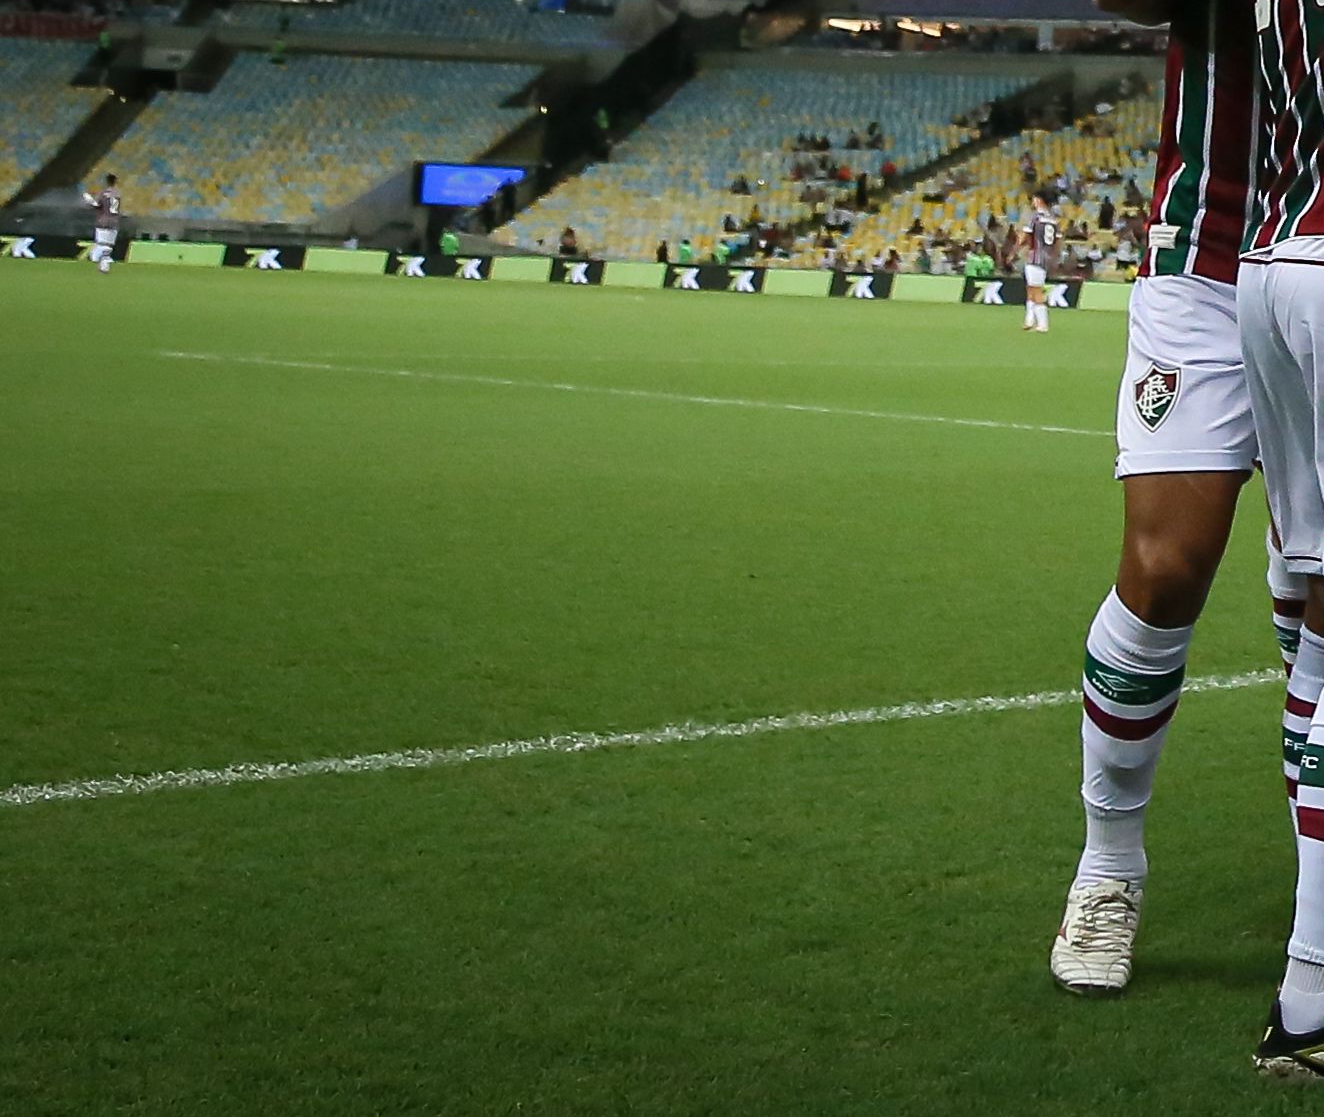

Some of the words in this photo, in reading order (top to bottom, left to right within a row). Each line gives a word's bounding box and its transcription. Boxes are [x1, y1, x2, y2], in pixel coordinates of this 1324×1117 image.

[245, 248, 281, 269] 7K
[397, 256, 426, 277] 7K
[456, 258, 482, 280] 7K
[564, 262, 589, 284] 7K
[674, 267, 700, 291] 7K
[728, 267, 755, 293] 7K
[846, 275, 874, 299] 7K
[974, 280, 1004, 305] 7K
[1284, 737, 1307, 751] FF
